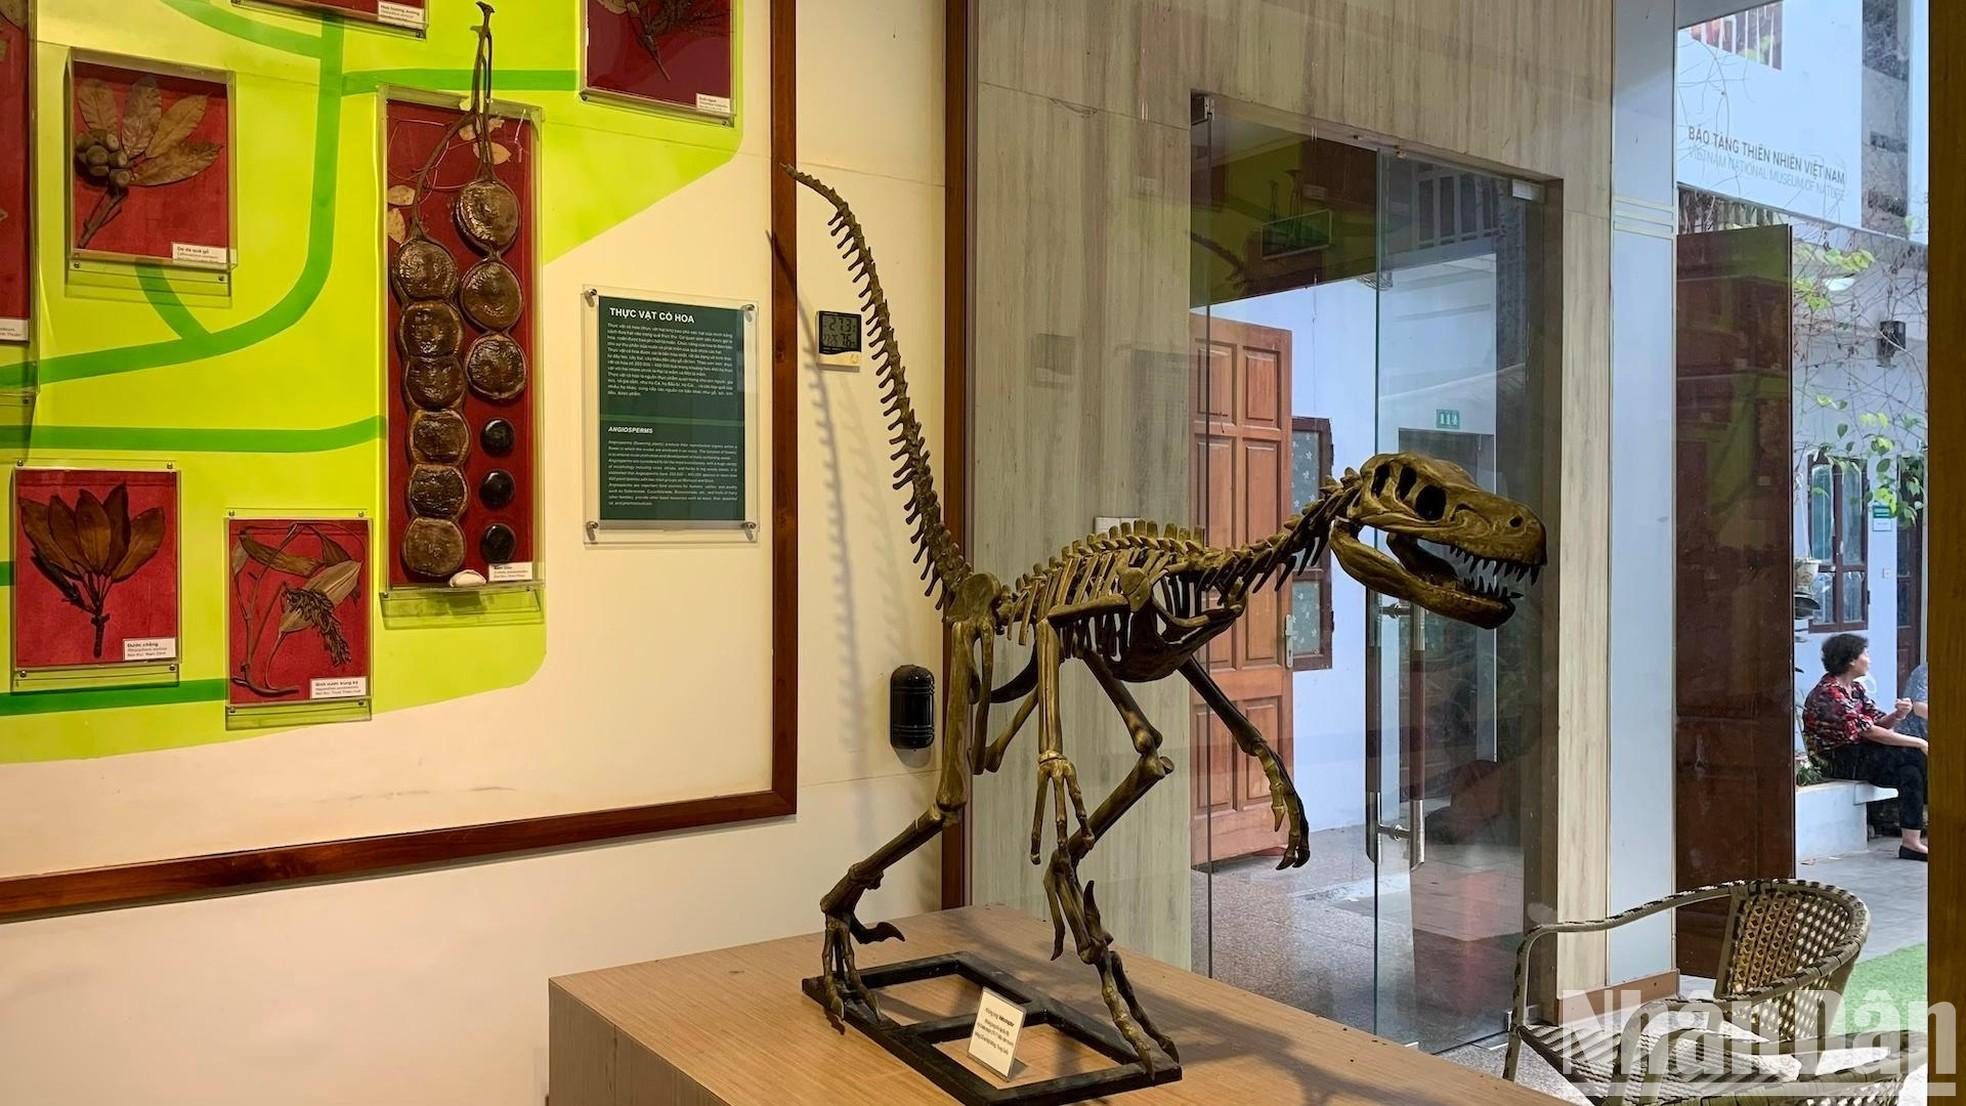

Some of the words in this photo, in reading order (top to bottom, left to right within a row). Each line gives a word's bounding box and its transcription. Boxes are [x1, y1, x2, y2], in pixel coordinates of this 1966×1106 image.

[1825, 167, 1846, 185] NAM
[609, 307, 637, 319] THỰC
[674, 313, 695, 323] HOA
[608, 426, 653, 434] ANGIOSPERMS
